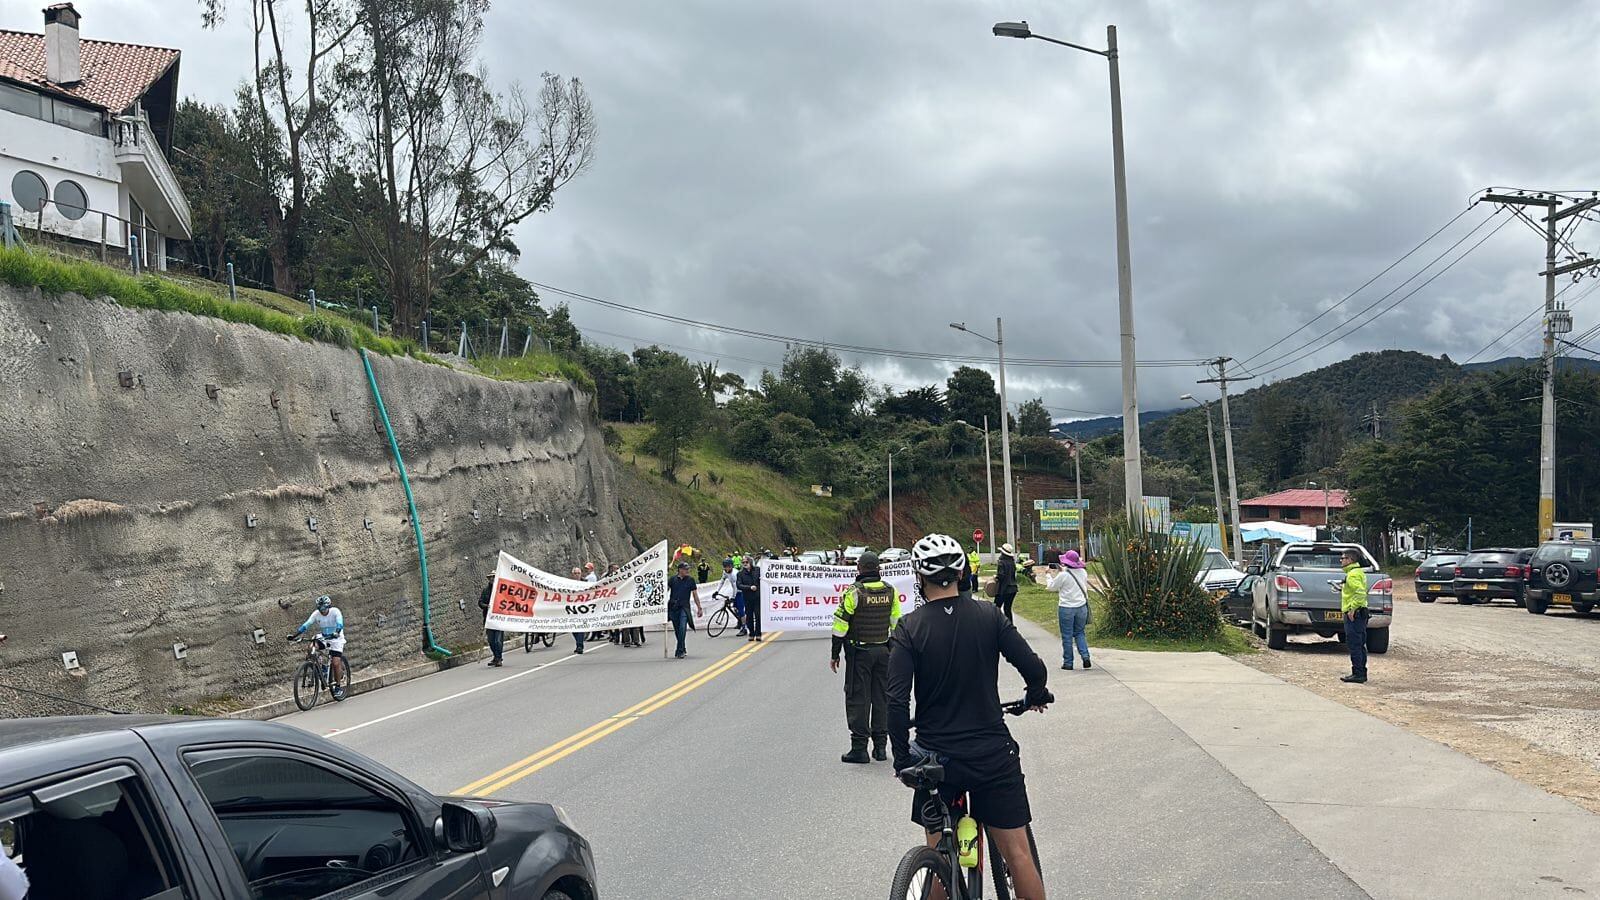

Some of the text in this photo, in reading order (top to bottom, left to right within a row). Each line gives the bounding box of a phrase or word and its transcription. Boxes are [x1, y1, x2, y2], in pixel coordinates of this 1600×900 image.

[768, 563, 784, 571] ¿POR
[765, 571, 779, 579] QUE
[780, 571, 802, 579] PAGAR
[880, 569, 910, 577] UESTROS
[499, 583, 537, 601] PEAJE
[543, 591, 562, 602] LA
[771, 586, 800, 597] PEAJE
[603, 599, 632, 613] ÚNETE
[772, 600, 800, 609] $ 200
[805, 596, 819, 605] EL
[565, 603, 597, 615] NO?
